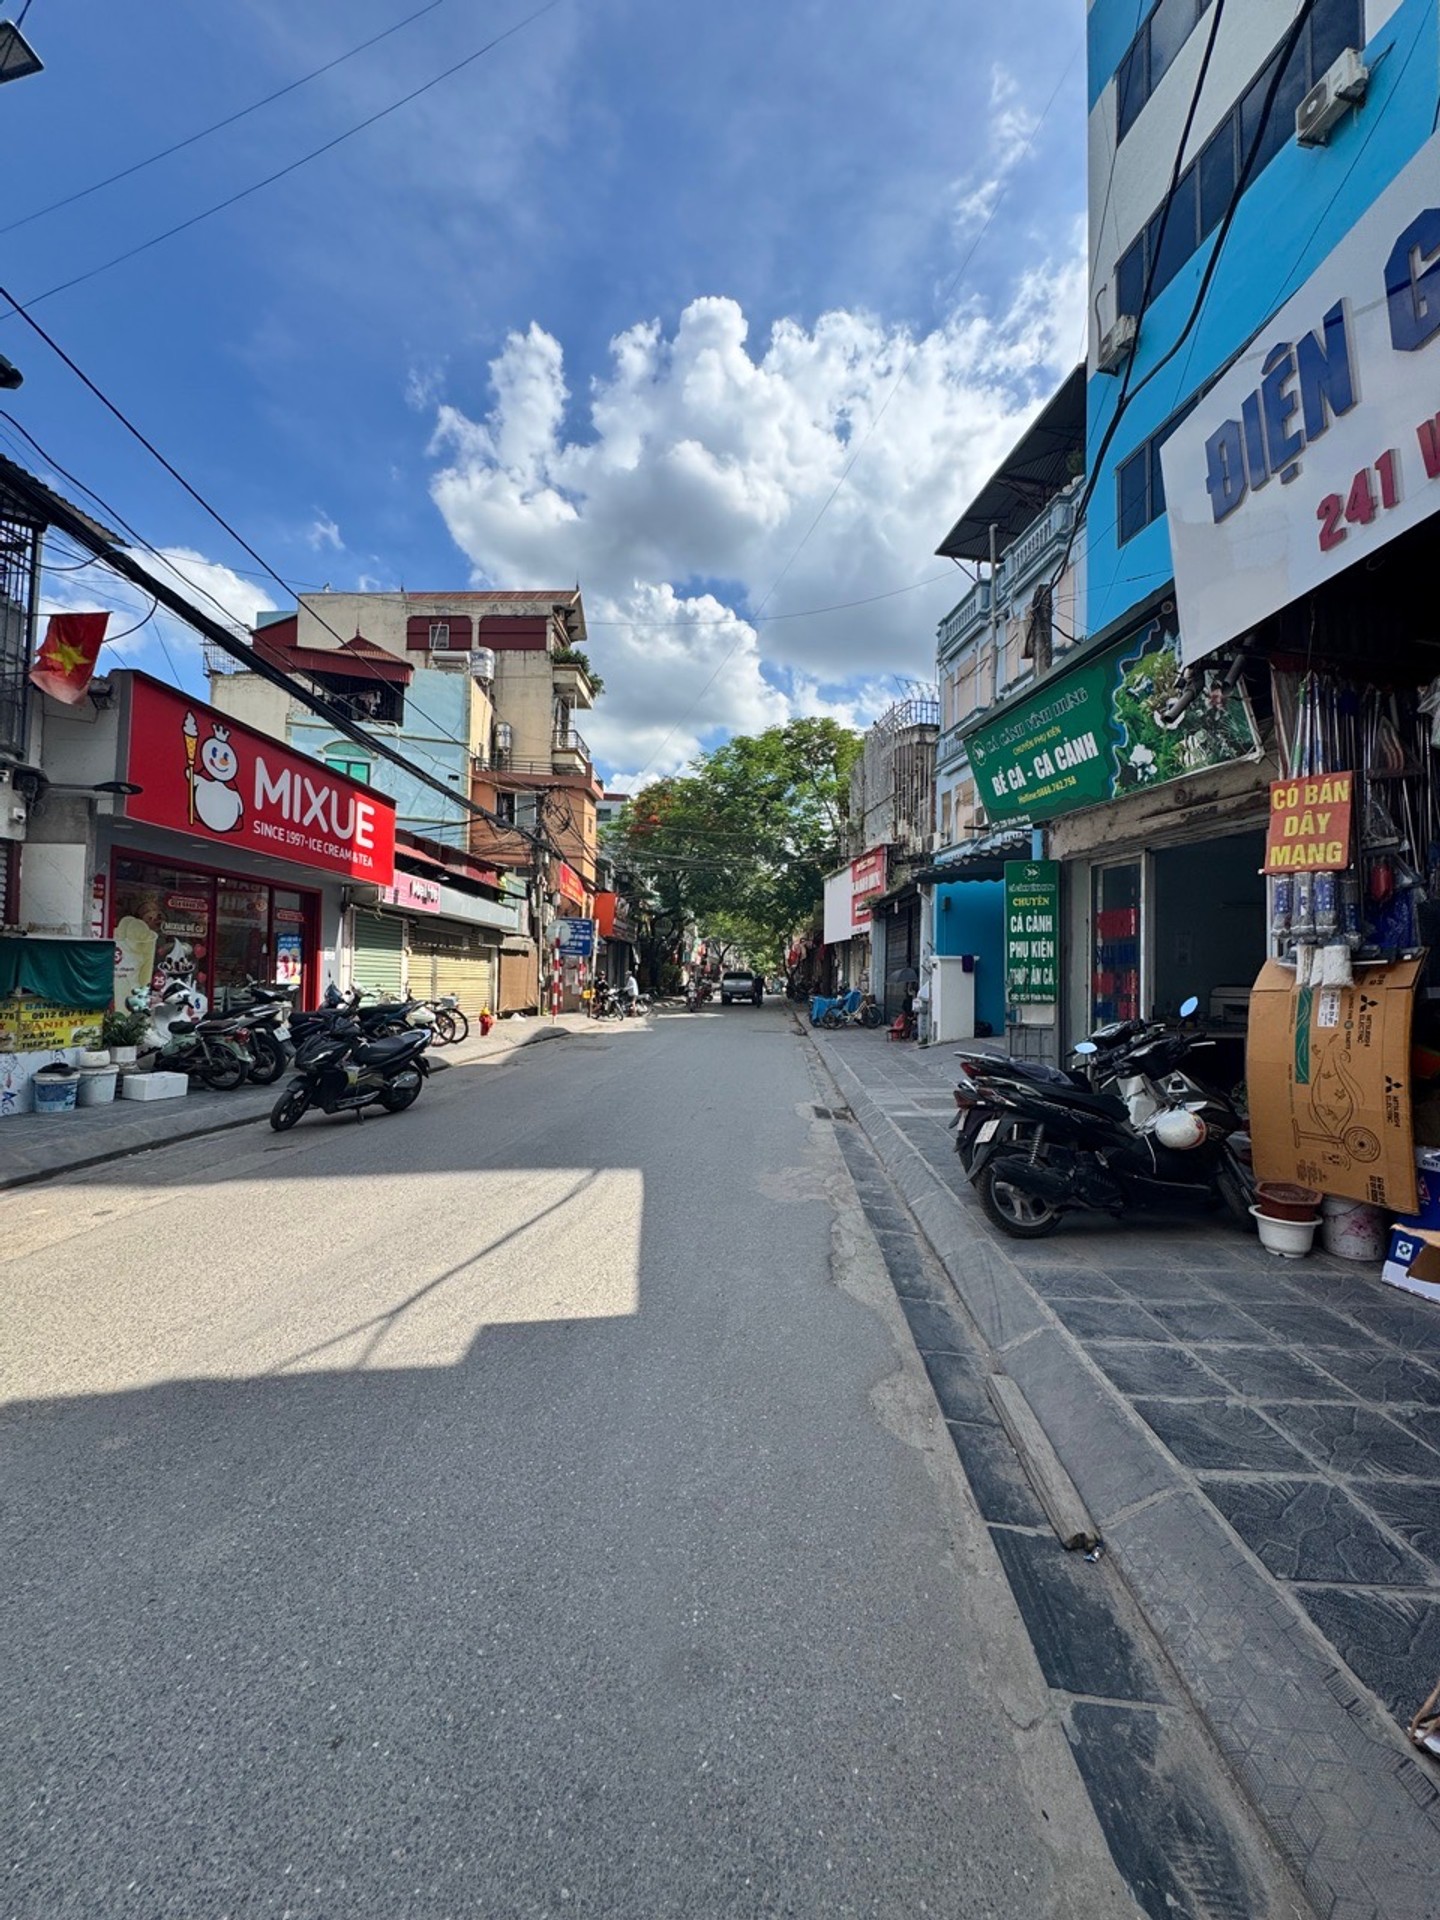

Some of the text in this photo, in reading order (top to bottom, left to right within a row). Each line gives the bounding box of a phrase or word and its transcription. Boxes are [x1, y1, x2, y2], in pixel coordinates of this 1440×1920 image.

[1204, 297, 1358, 525] ĐIỆN
[1317, 449, 1399, 552] 241
[1007, 762, 1027, 791] CÁ
[1033, 749, 1056, 780] CÁ
[1055, 731, 1100, 771] CẢNH
[254, 756, 375, 849] MIXUE
[1272, 777, 1350, 811] CÓ BÁN
[1283, 811, 1332, 837] DÂY
[253, 820, 285, 842] SINCE
[323, 840, 352, 860] CREAM
[1270, 841, 1343, 870] MẠNG
[1012, 895, 1050, 907] CHUYÊN
[1010, 909, 1053, 933] CÁ CẢNH
[1009, 937, 1054, 962] PHỤ KIỆN
[1030, 964, 1042, 985] ĂN
[1042, 964, 1055, 985] CÁ
